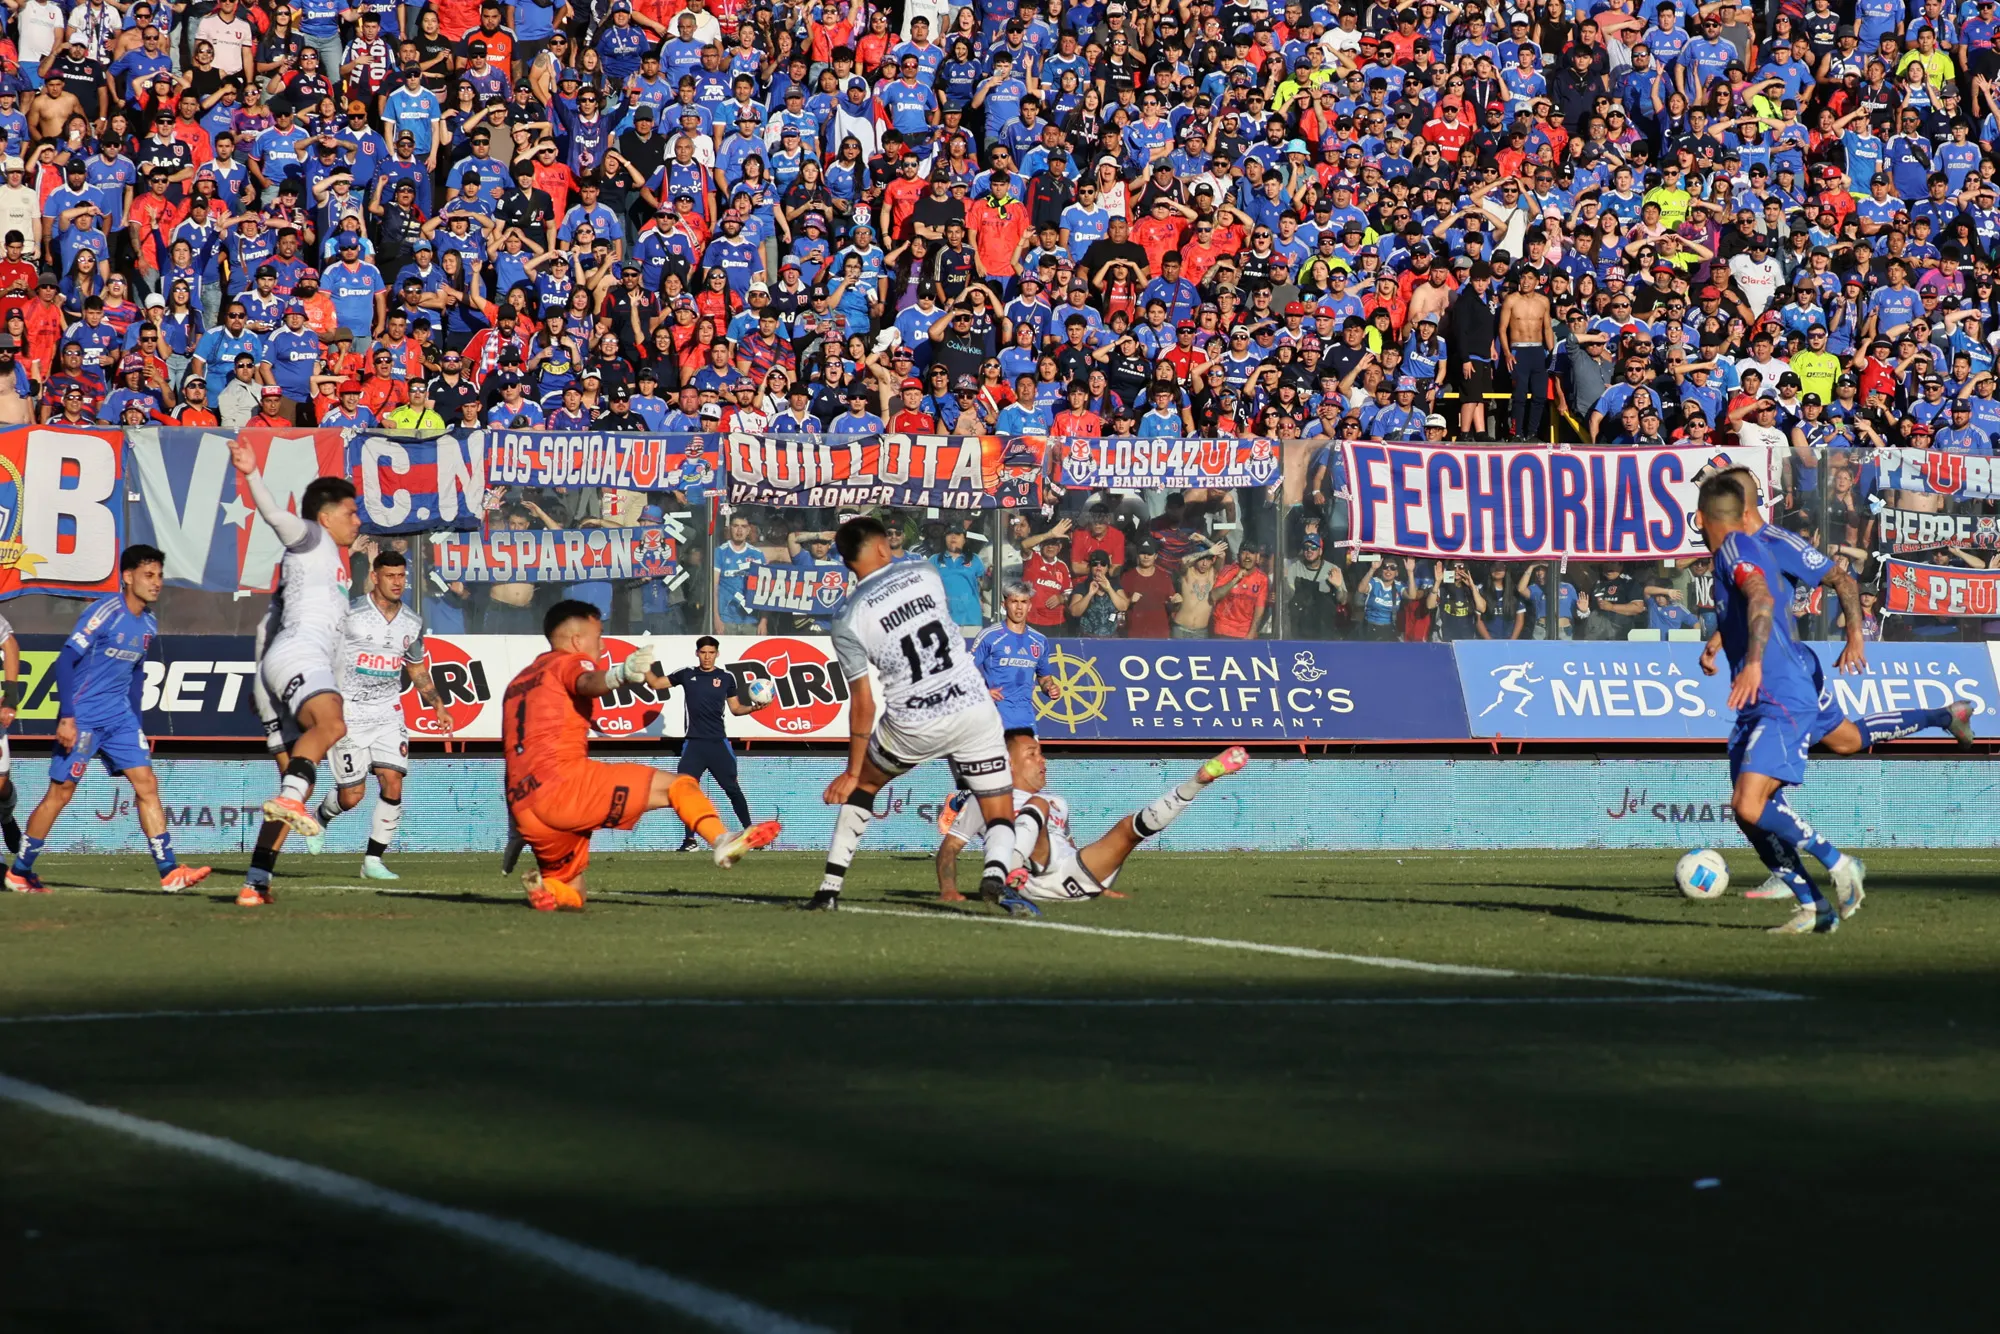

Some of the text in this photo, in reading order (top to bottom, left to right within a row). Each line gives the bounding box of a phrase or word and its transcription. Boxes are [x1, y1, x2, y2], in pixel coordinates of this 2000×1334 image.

[1741, 275, 1769, 286] Claro
[779, 311, 796, 324] Ad
[490, 434, 669, 488] LOS SOCIOAZUL
[728, 433, 984, 490] QUILLOTA
[1098, 438, 1243, 477] LOSC4ZUL
[1089, 475, 1252, 489] LA BANDA DEL TERROR
[731, 484, 984, 509] HASTA ROMPER LA VOZ
[1350, 444, 1685, 554] FECHORIAS
[1880, 508, 1972, 544] FIEBRE
[753, 565, 818, 611] DALE
[1929, 576, 2000, 615] PEU
[879, 594, 936, 634] ROMERO
[1119, 655, 1281, 681] OCEAN
[1563, 662, 1682, 676] CLINICA
[1125, 687, 1355, 713] PACIFIC'S
[1550, 679, 1706, 718] MEDS
[597, 717, 633, 731] Cola
[775, 717, 812, 731] Cola
[1132, 717, 1323, 728] RESTAURANT
[343, 753, 354, 773] 3
[959, 758, 1006, 775] FUSO
[166, 806, 263, 827] MART
[1651, 802, 1735, 823] SMAR
